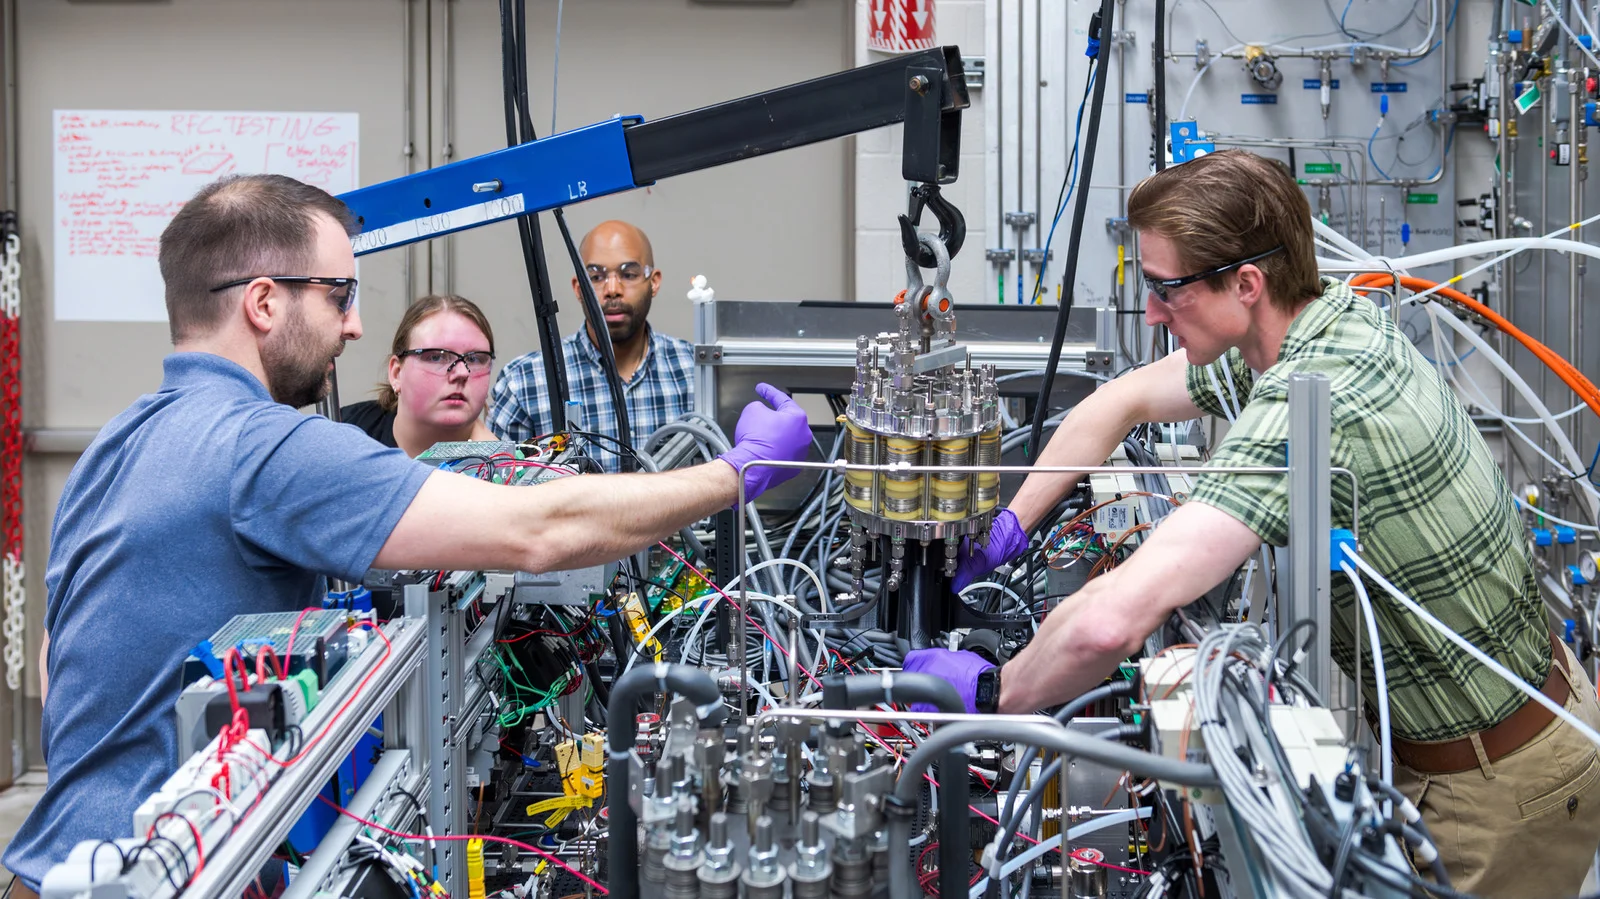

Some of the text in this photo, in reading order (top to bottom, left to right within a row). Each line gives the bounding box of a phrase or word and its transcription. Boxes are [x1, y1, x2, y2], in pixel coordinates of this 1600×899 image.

[171, 115, 221, 135] RFC
[224, 116, 341, 141] TESTING
[415, 212, 451, 236] 1500
[484, 195, 522, 220] 1000
[567, 180, 588, 200] LB
